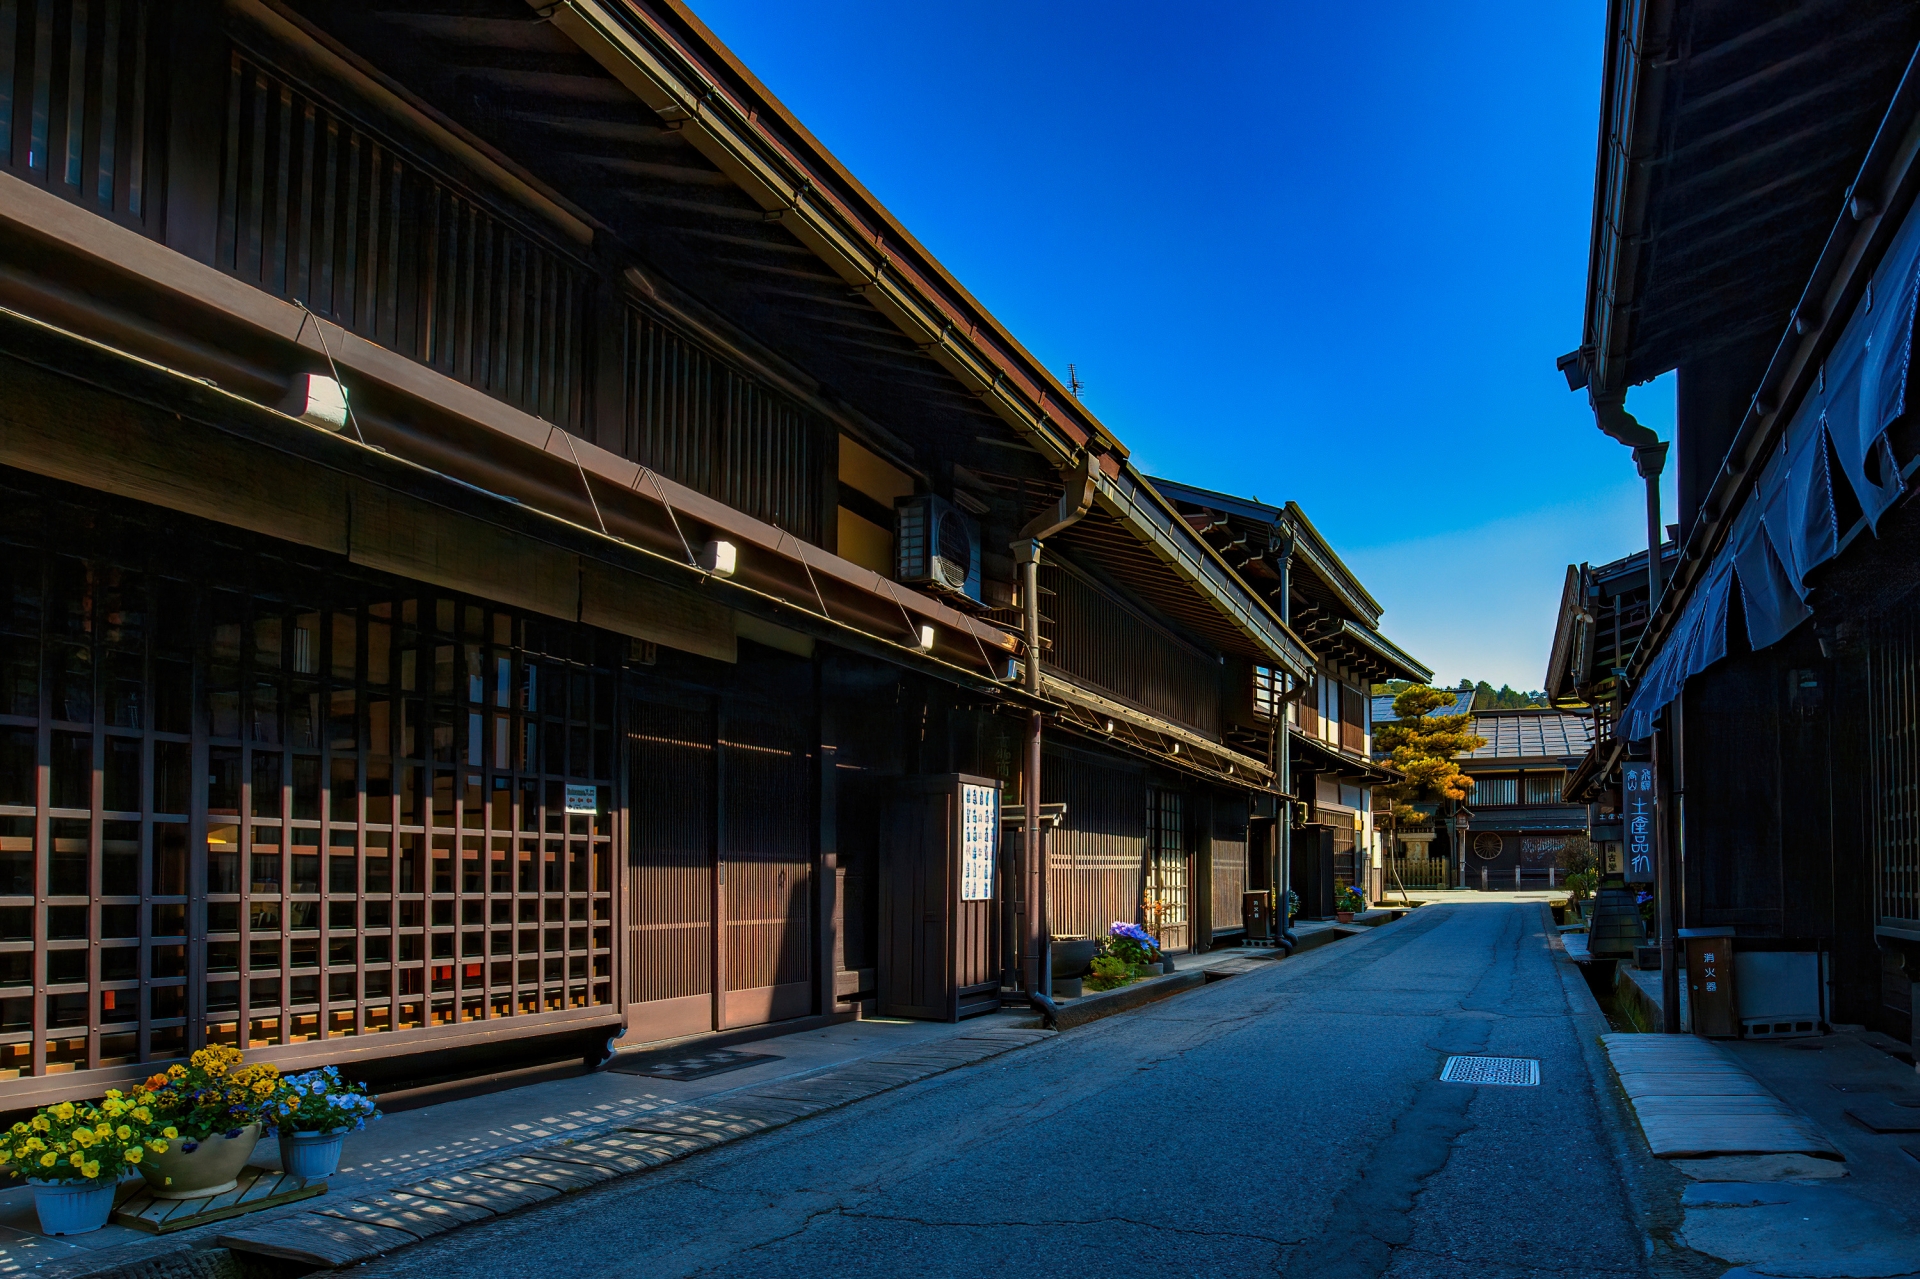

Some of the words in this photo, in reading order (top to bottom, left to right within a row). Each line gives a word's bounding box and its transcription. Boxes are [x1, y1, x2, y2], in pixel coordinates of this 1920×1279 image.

[1627, 769, 1638, 791] 高山
[1704, 953, 1717, 991] 消火器
